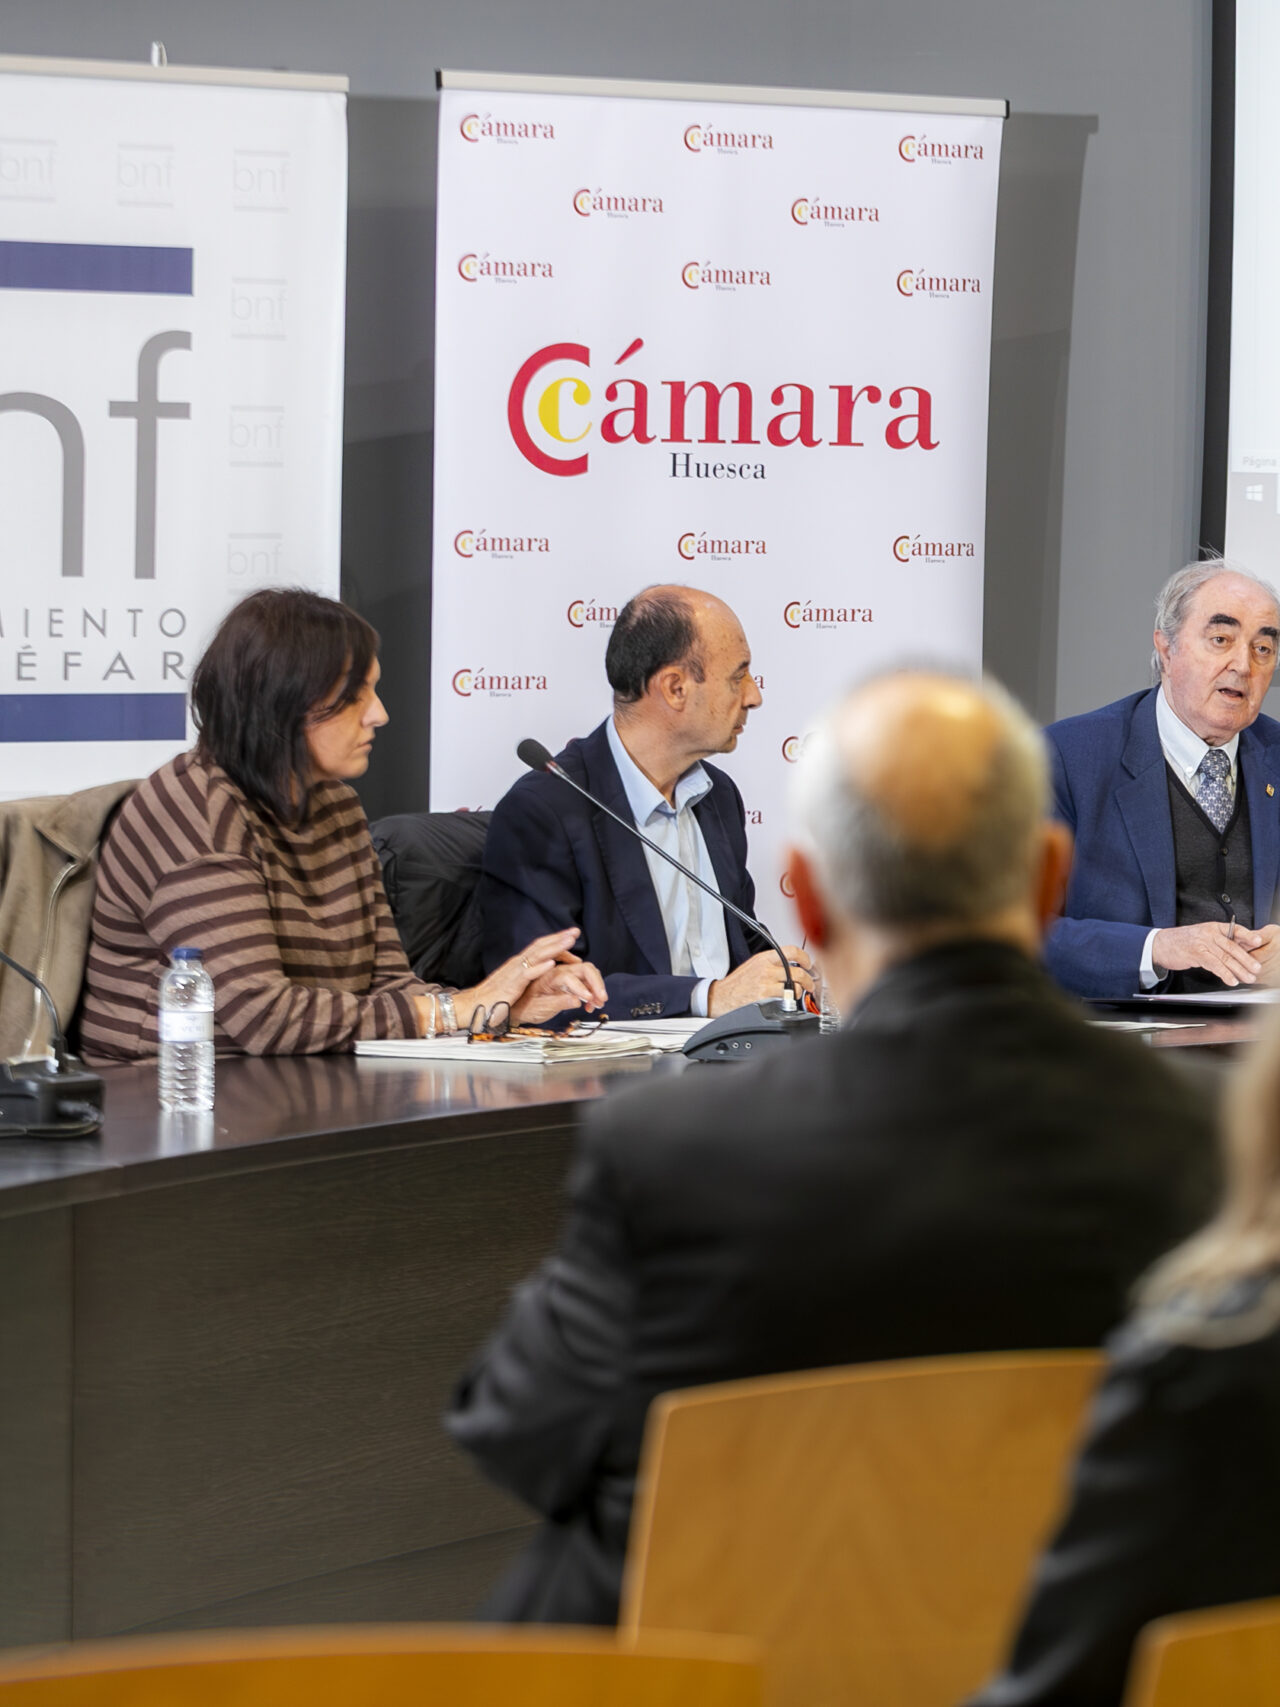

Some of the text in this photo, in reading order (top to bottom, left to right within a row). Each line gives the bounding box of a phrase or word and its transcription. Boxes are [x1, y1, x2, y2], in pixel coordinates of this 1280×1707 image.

[117, 152, 174, 188] bnf
[233, 159, 289, 193] bnf
[231, 287, 287, 321] bnf
[229, 414, 286, 449] bnf
[668, 452, 768, 480] Huesca
[227, 542, 283, 577] bnf
[0, 608, 187, 638] IENTO
